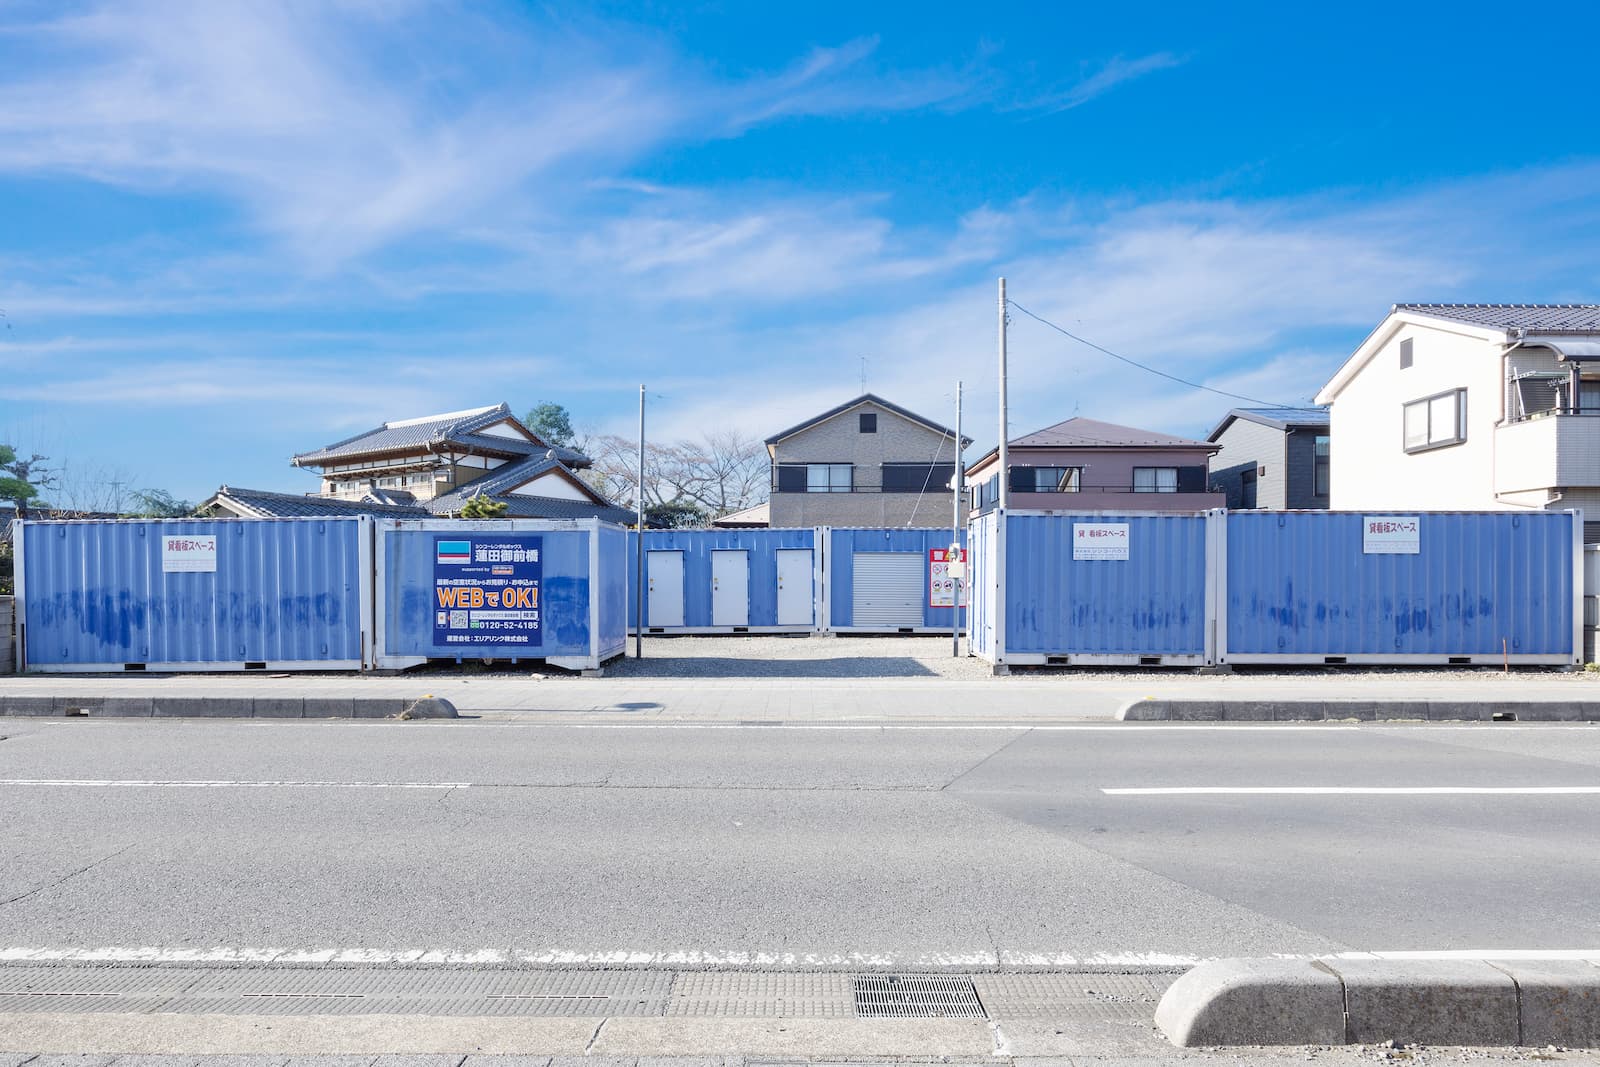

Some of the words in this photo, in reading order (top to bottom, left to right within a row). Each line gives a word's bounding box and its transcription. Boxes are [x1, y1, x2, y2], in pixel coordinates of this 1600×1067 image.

[1369, 521, 1416, 534] 貸看板スペース
[167, 539, 215, 552] 貸看板スペース
[475, 549, 539, 563] 蓮田御前橋
[479, 621, 539, 630] 0120-52-4185
